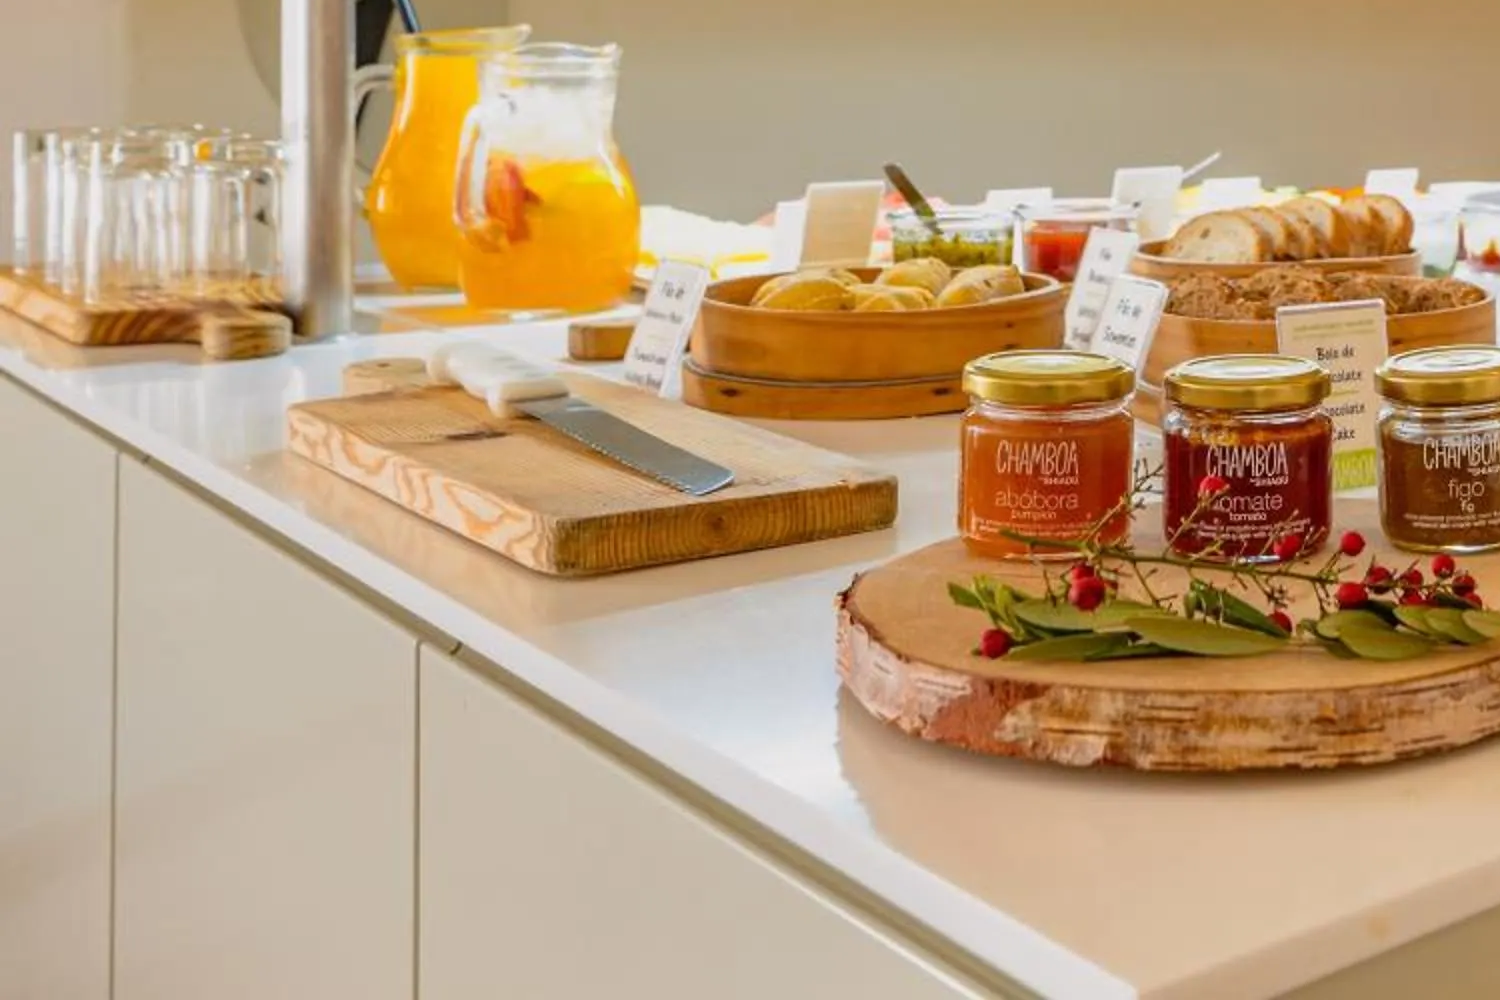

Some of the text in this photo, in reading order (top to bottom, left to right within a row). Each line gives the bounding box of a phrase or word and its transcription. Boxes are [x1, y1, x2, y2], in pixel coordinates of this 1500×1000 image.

[995, 439, 1079, 476] CHAMBOA
[1206, 441, 1289, 478] CHAMBOA
[1448, 479, 1485, 501] figo
[1229, 511, 1267, 521] tomato
